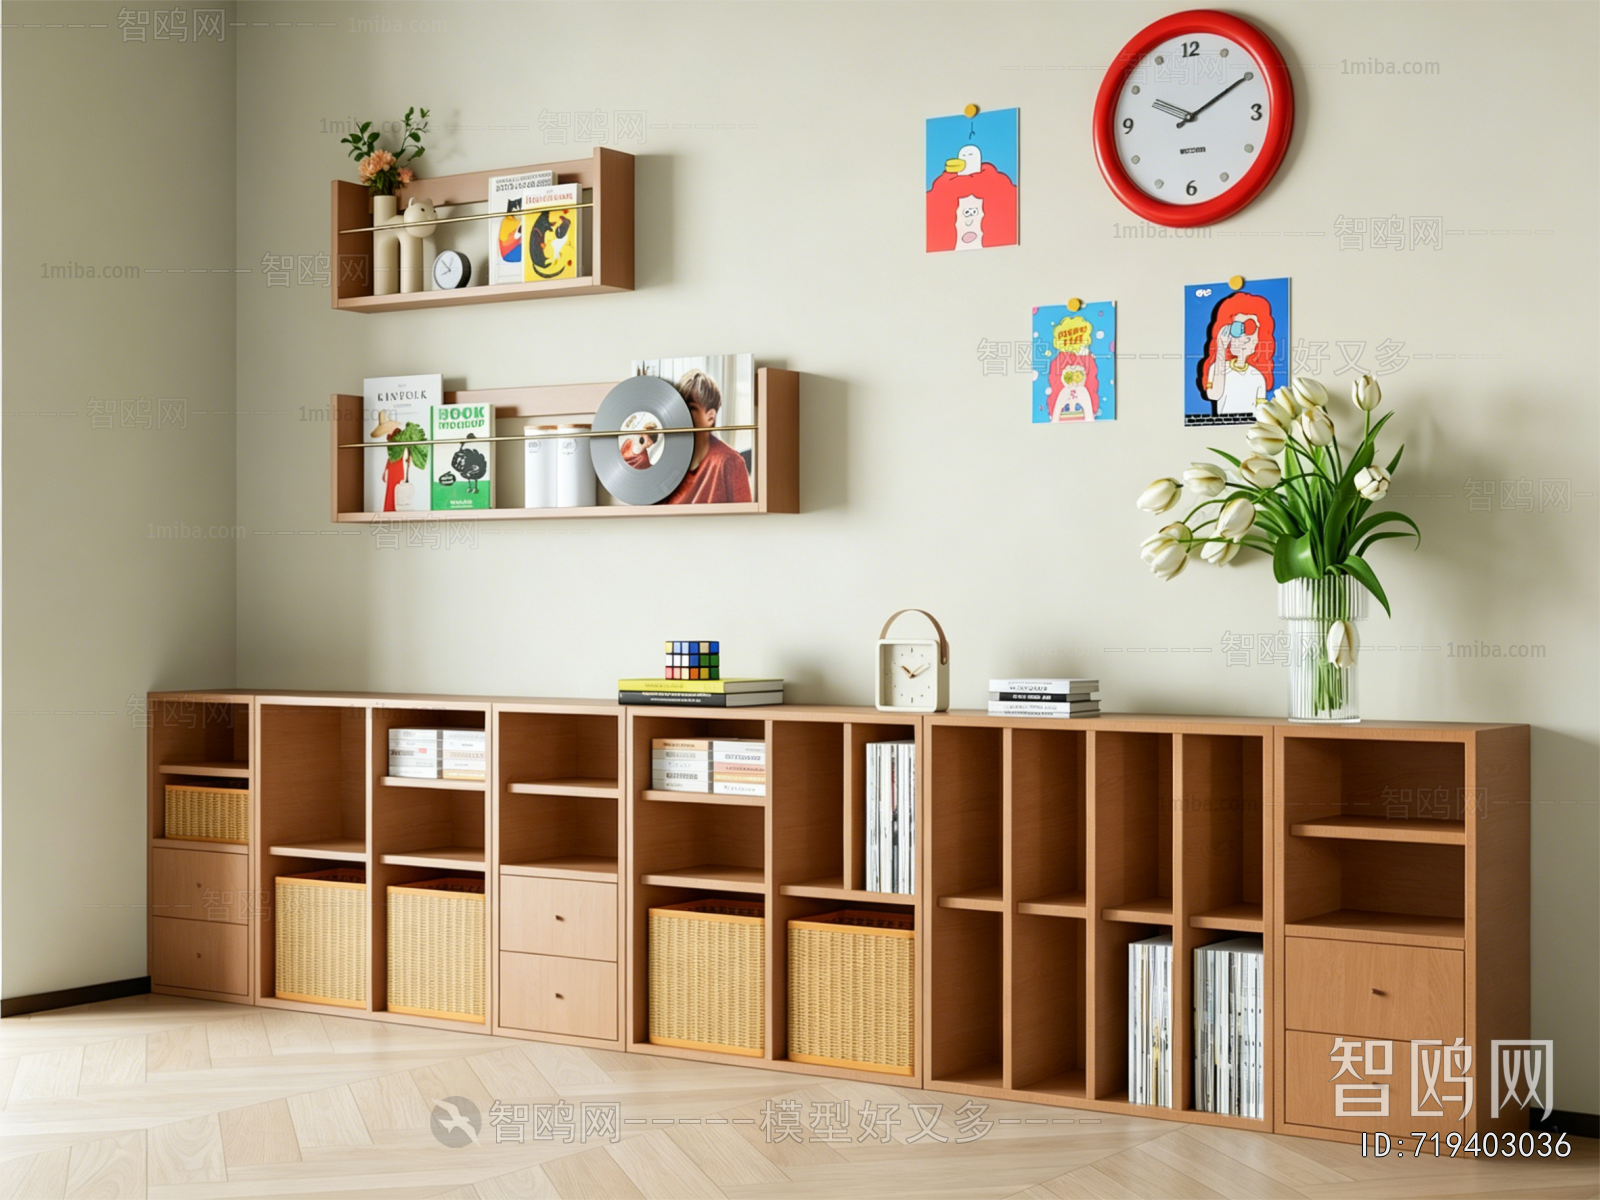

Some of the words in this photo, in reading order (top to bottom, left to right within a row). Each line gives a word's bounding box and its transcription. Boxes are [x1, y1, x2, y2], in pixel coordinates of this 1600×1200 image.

[1181, 41, 1200, 58] 12
[1250, 103, 1263, 121] 3
[1122, 118, 1134, 135] 9
[1185, 180, 1198, 196] 6
[377, 390, 427, 402] KINFOLK
[438, 406, 485, 420] BOOK
